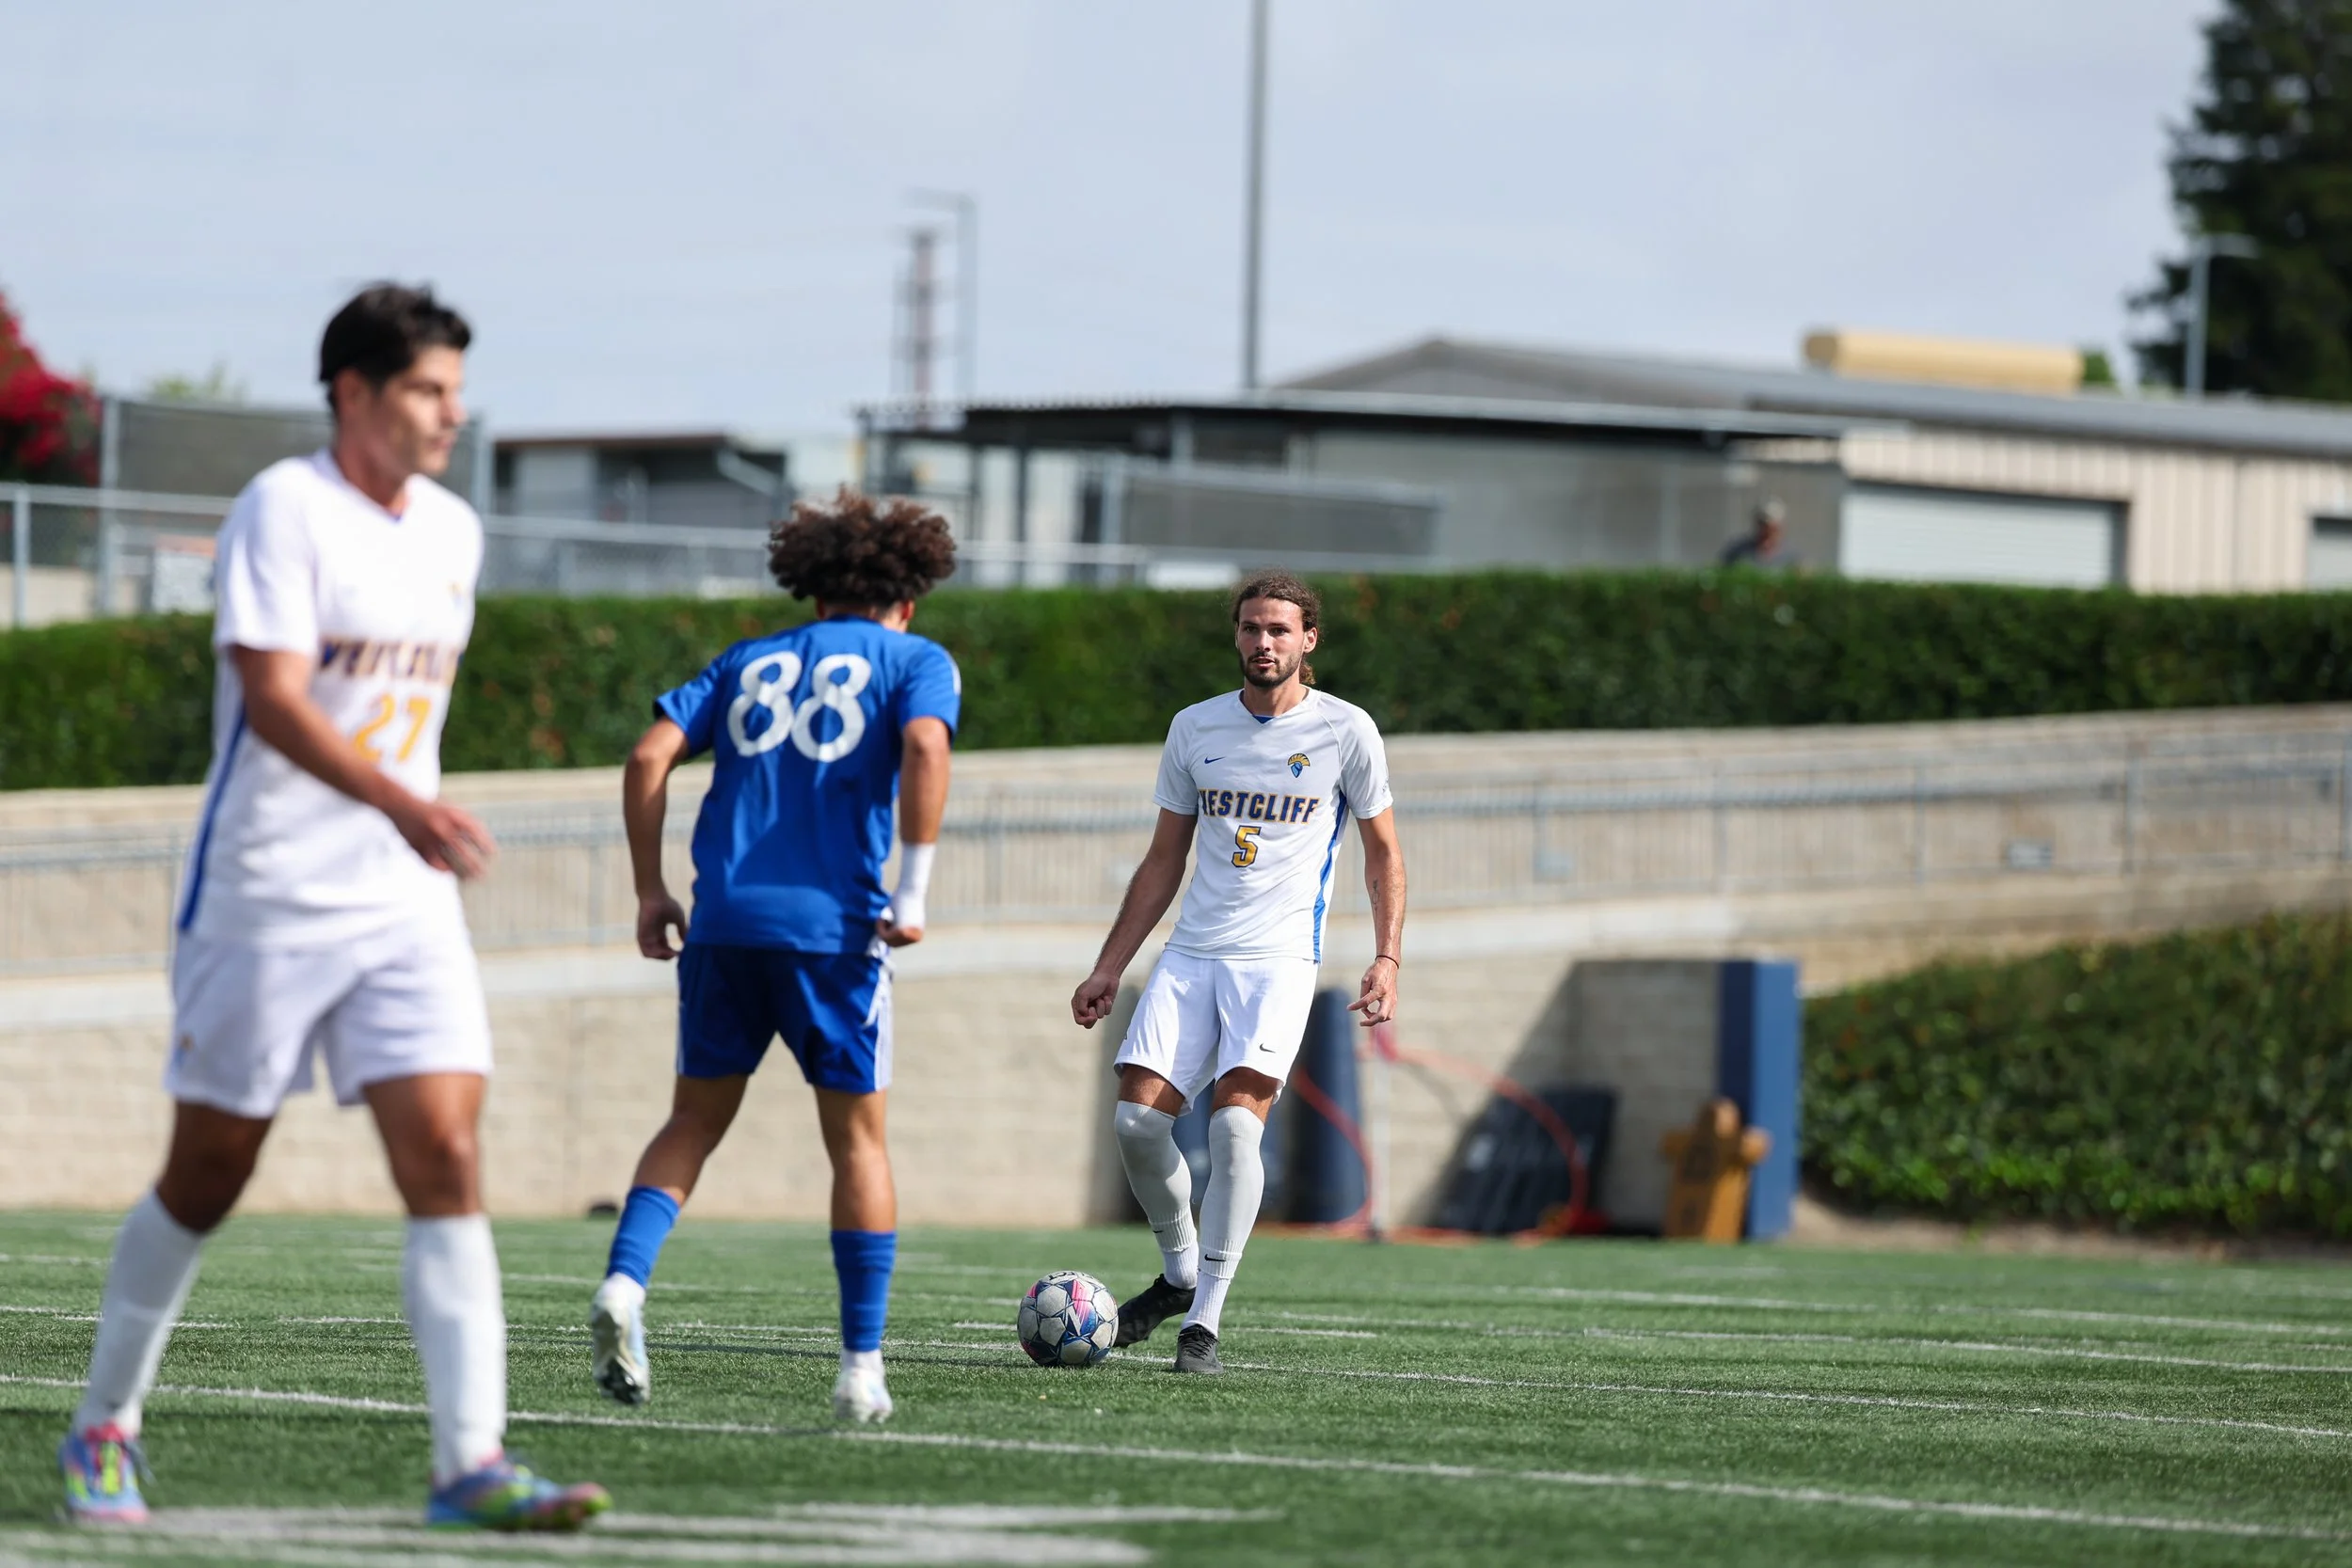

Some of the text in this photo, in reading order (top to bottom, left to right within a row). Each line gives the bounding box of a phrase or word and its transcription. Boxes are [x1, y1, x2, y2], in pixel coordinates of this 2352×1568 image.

[350, 691, 432, 764] 27
[727, 651, 871, 763] 88
[1231, 824, 1262, 867] 5
